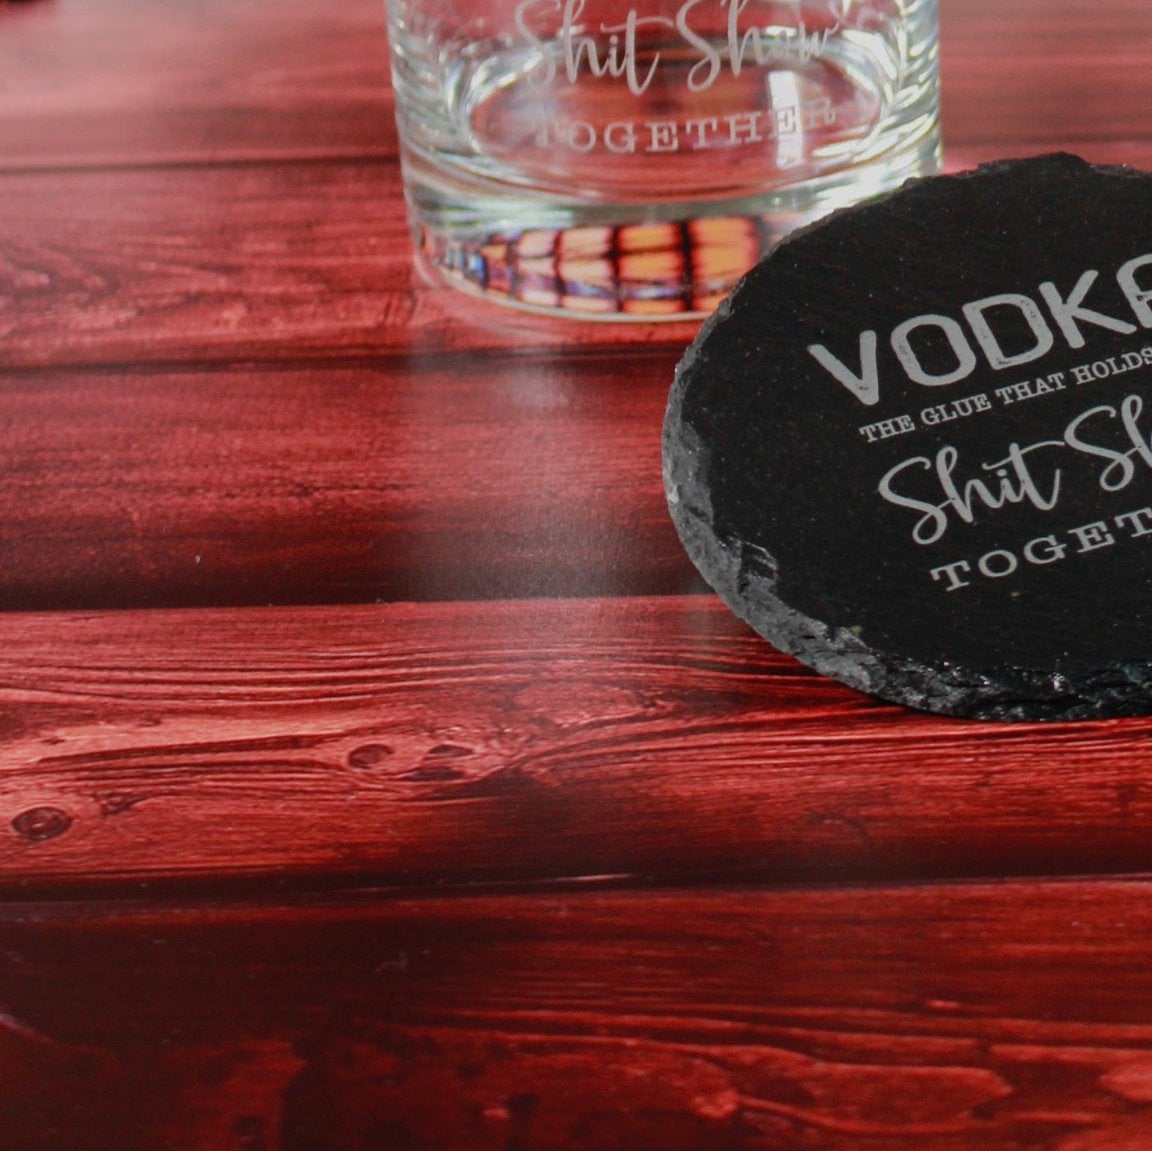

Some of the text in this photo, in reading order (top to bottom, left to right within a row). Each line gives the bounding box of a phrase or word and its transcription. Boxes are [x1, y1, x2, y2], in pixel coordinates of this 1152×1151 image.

[858, 414, 915, 443] THE
[920, 393, 993, 427] GLUE
[995, 372, 1067, 406] THAT
[877, 441, 1067, 545] Shit
